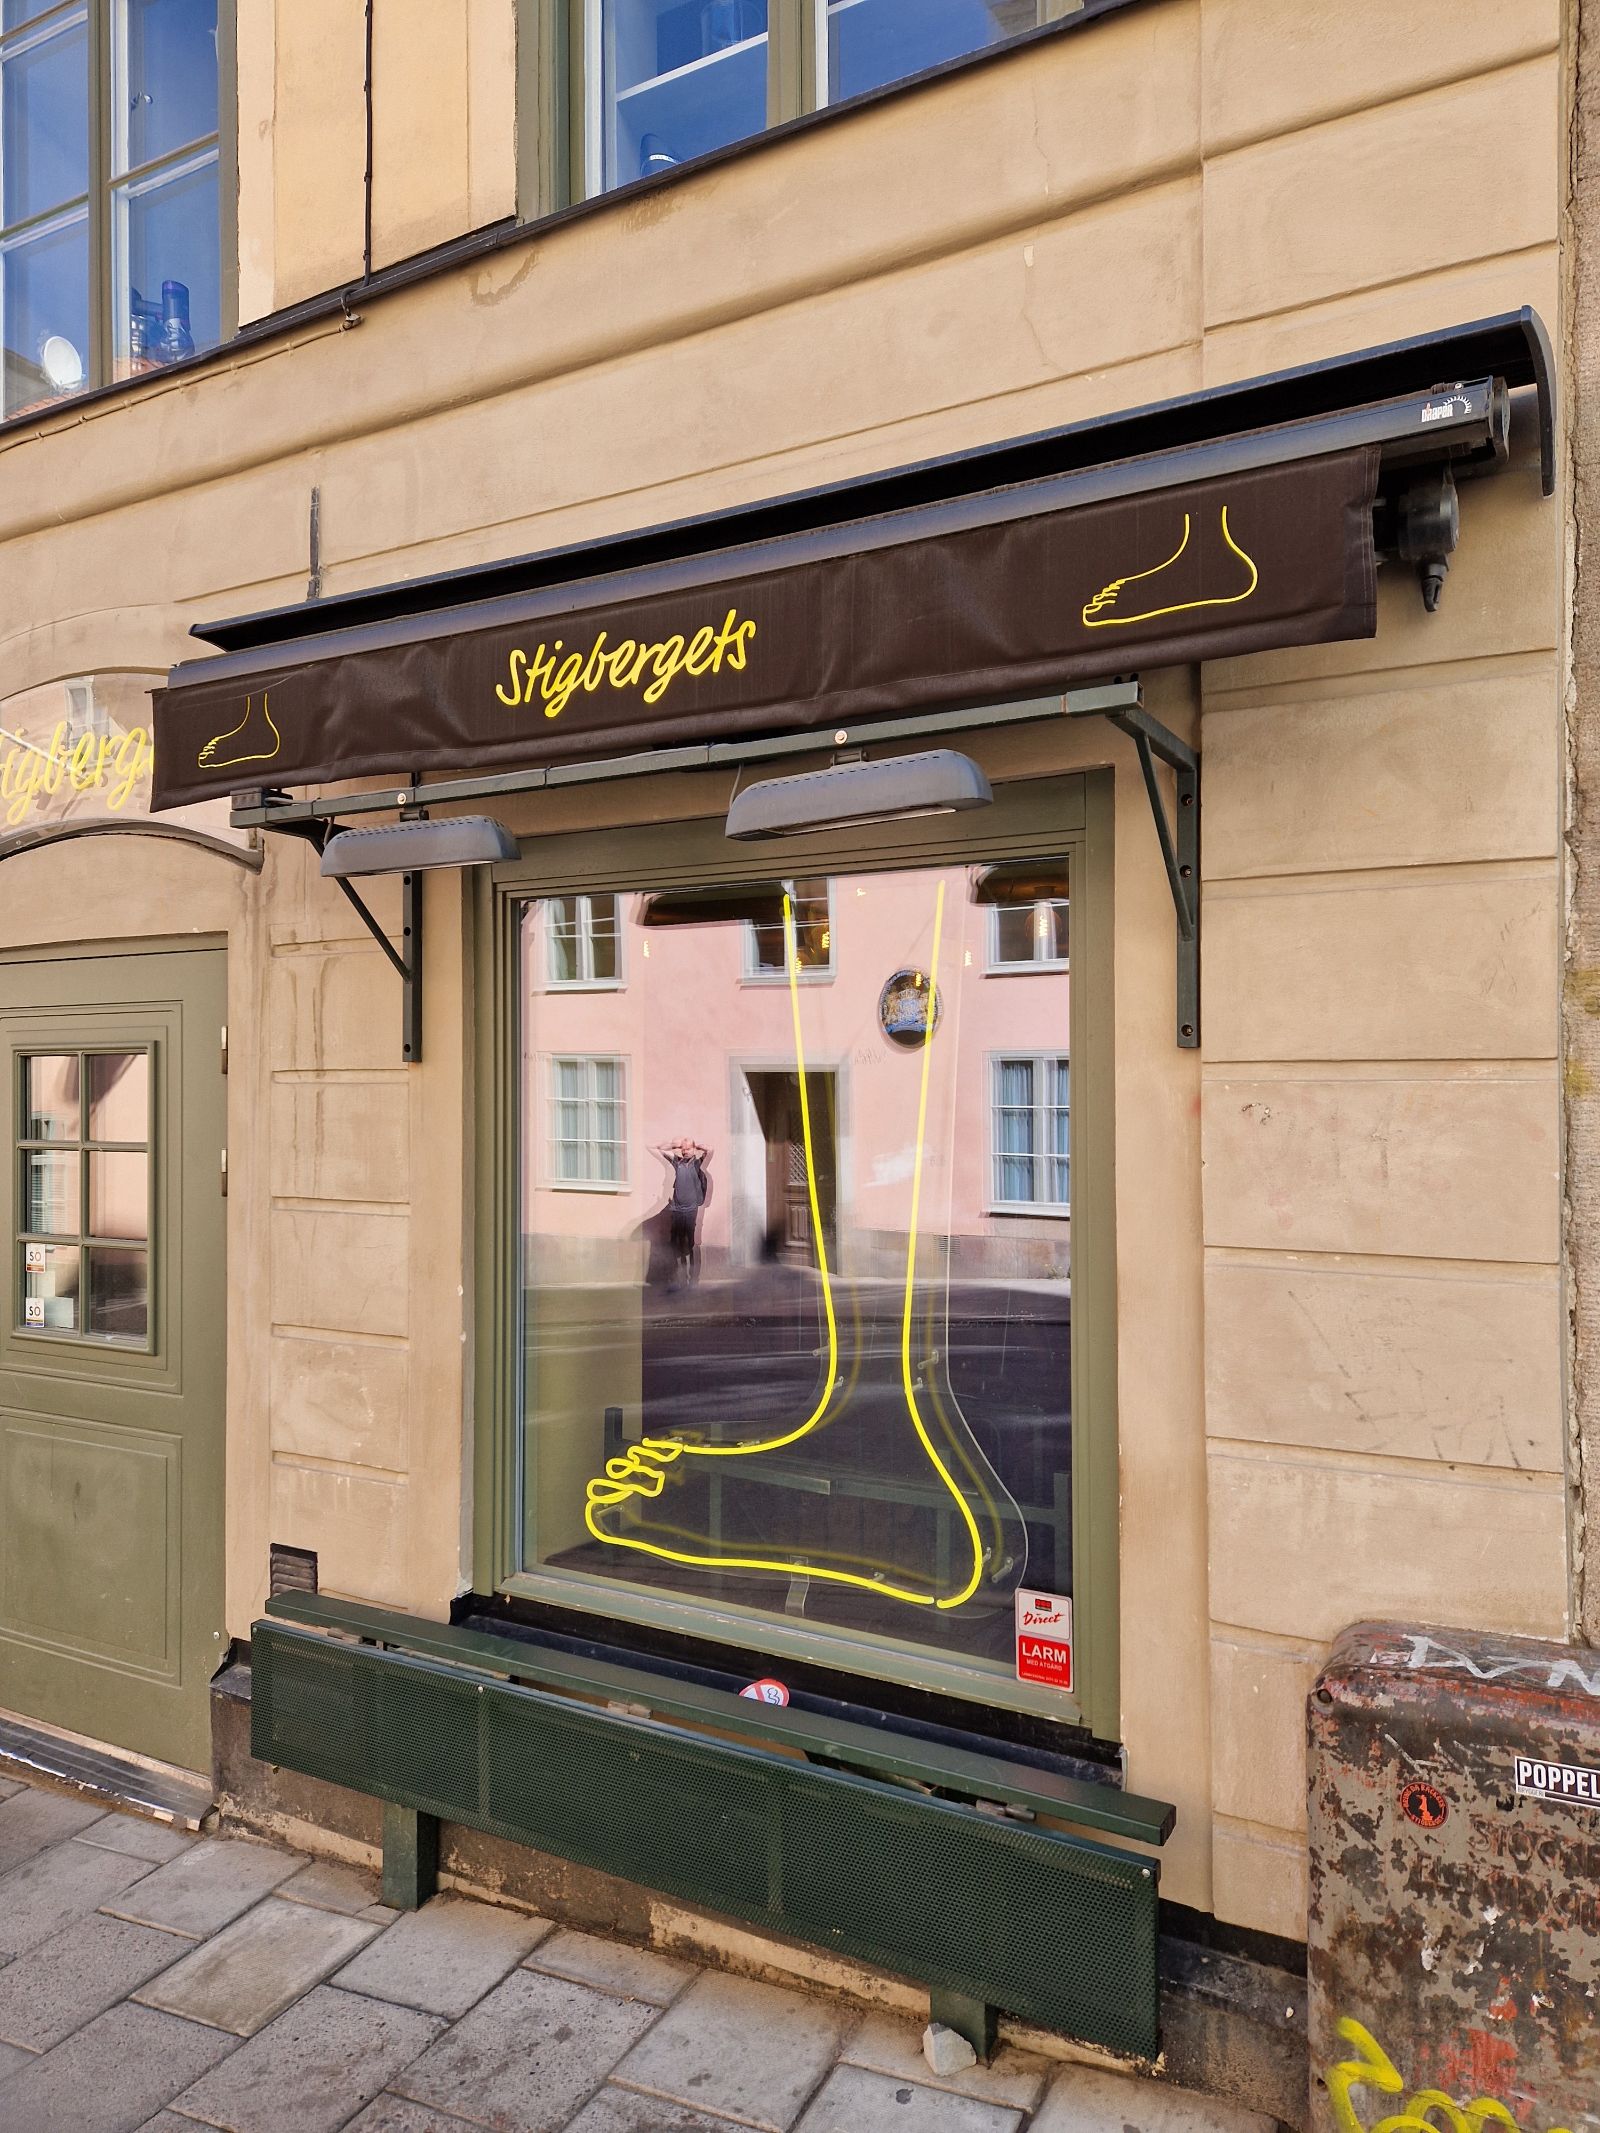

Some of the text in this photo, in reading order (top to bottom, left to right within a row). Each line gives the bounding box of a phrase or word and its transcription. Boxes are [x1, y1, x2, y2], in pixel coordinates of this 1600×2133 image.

[496, 609, 756, 717] Stigbergets
[0, 720, 154, 826] igberg
[1022, 1641, 1067, 1665] LARM
[1519, 1760, 1600, 1799] POPPEL
